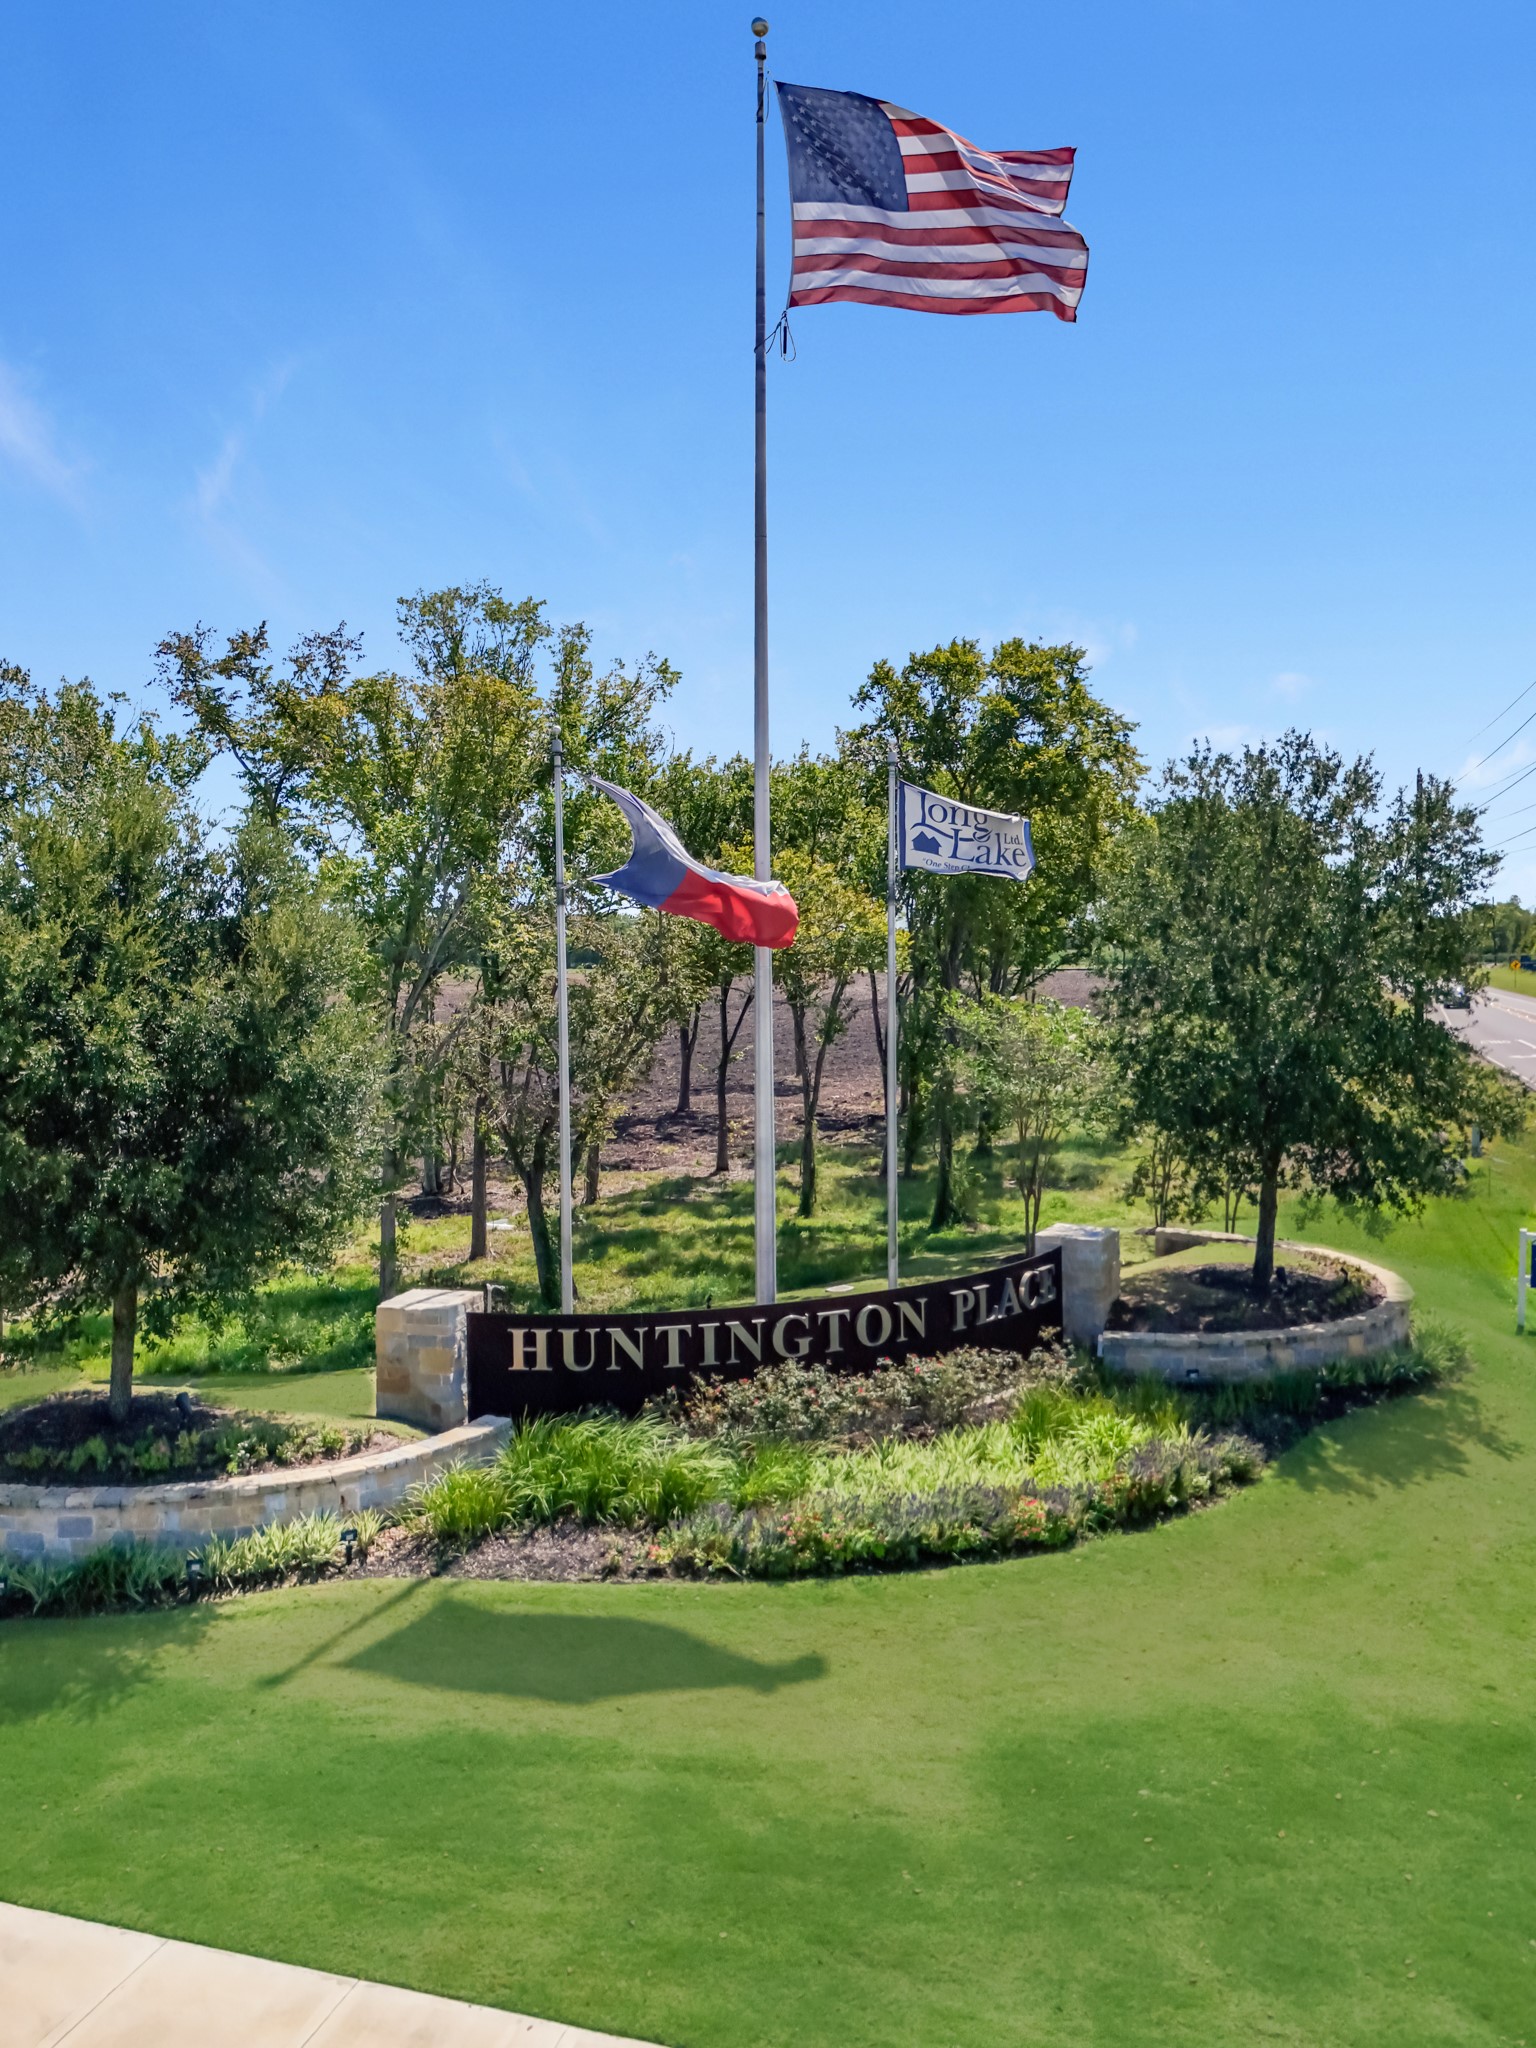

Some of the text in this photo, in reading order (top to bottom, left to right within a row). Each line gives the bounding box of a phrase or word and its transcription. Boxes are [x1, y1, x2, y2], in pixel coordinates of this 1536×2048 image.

[948, 828, 1026, 867] Lake
[1003, 832, 1024, 846] Ltd.
[507, 1263, 1057, 1372] HUNTINGTON PLACE
